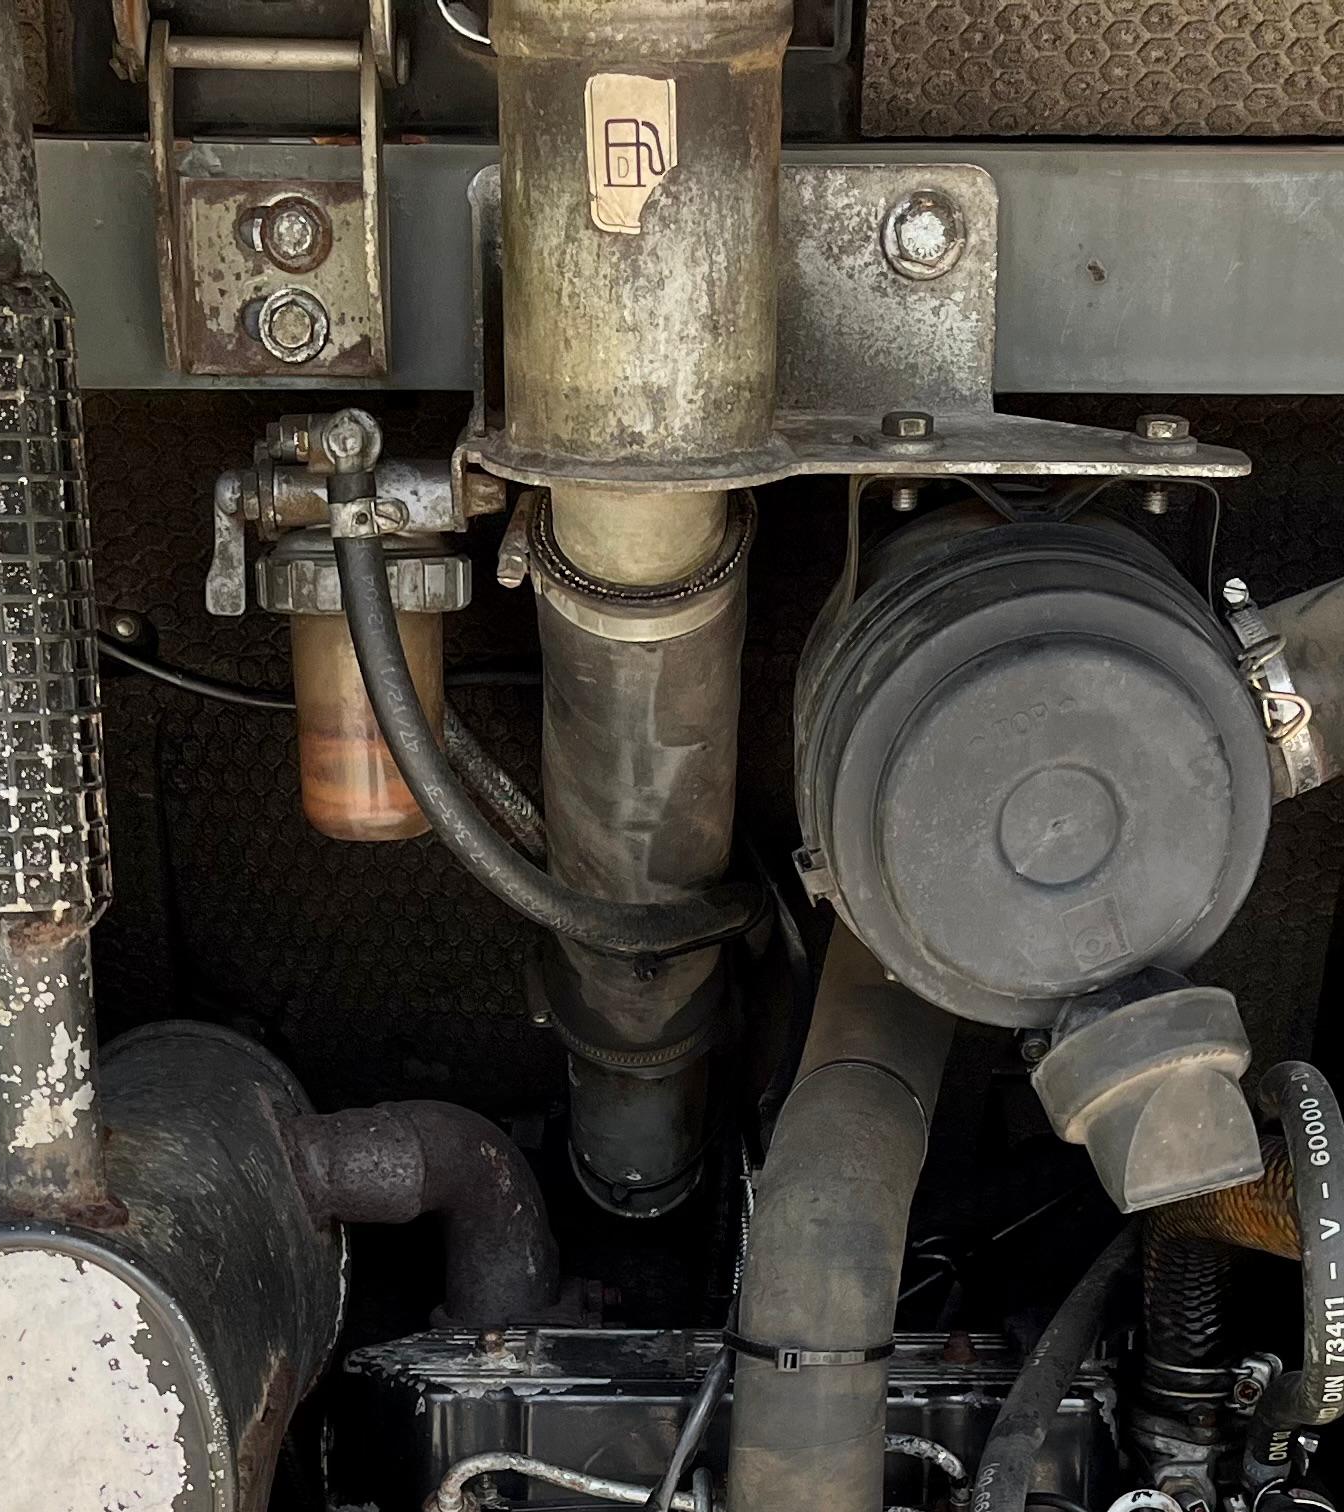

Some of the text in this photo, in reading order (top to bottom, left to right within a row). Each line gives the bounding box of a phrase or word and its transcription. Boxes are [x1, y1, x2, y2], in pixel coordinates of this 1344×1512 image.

[617, 156, 630, 179] D
[1297, 1097, 1332, 1167] 60000
[1319, 1218, 1341, 1240] V
[1268, 1441, 1289, 1461] DN
